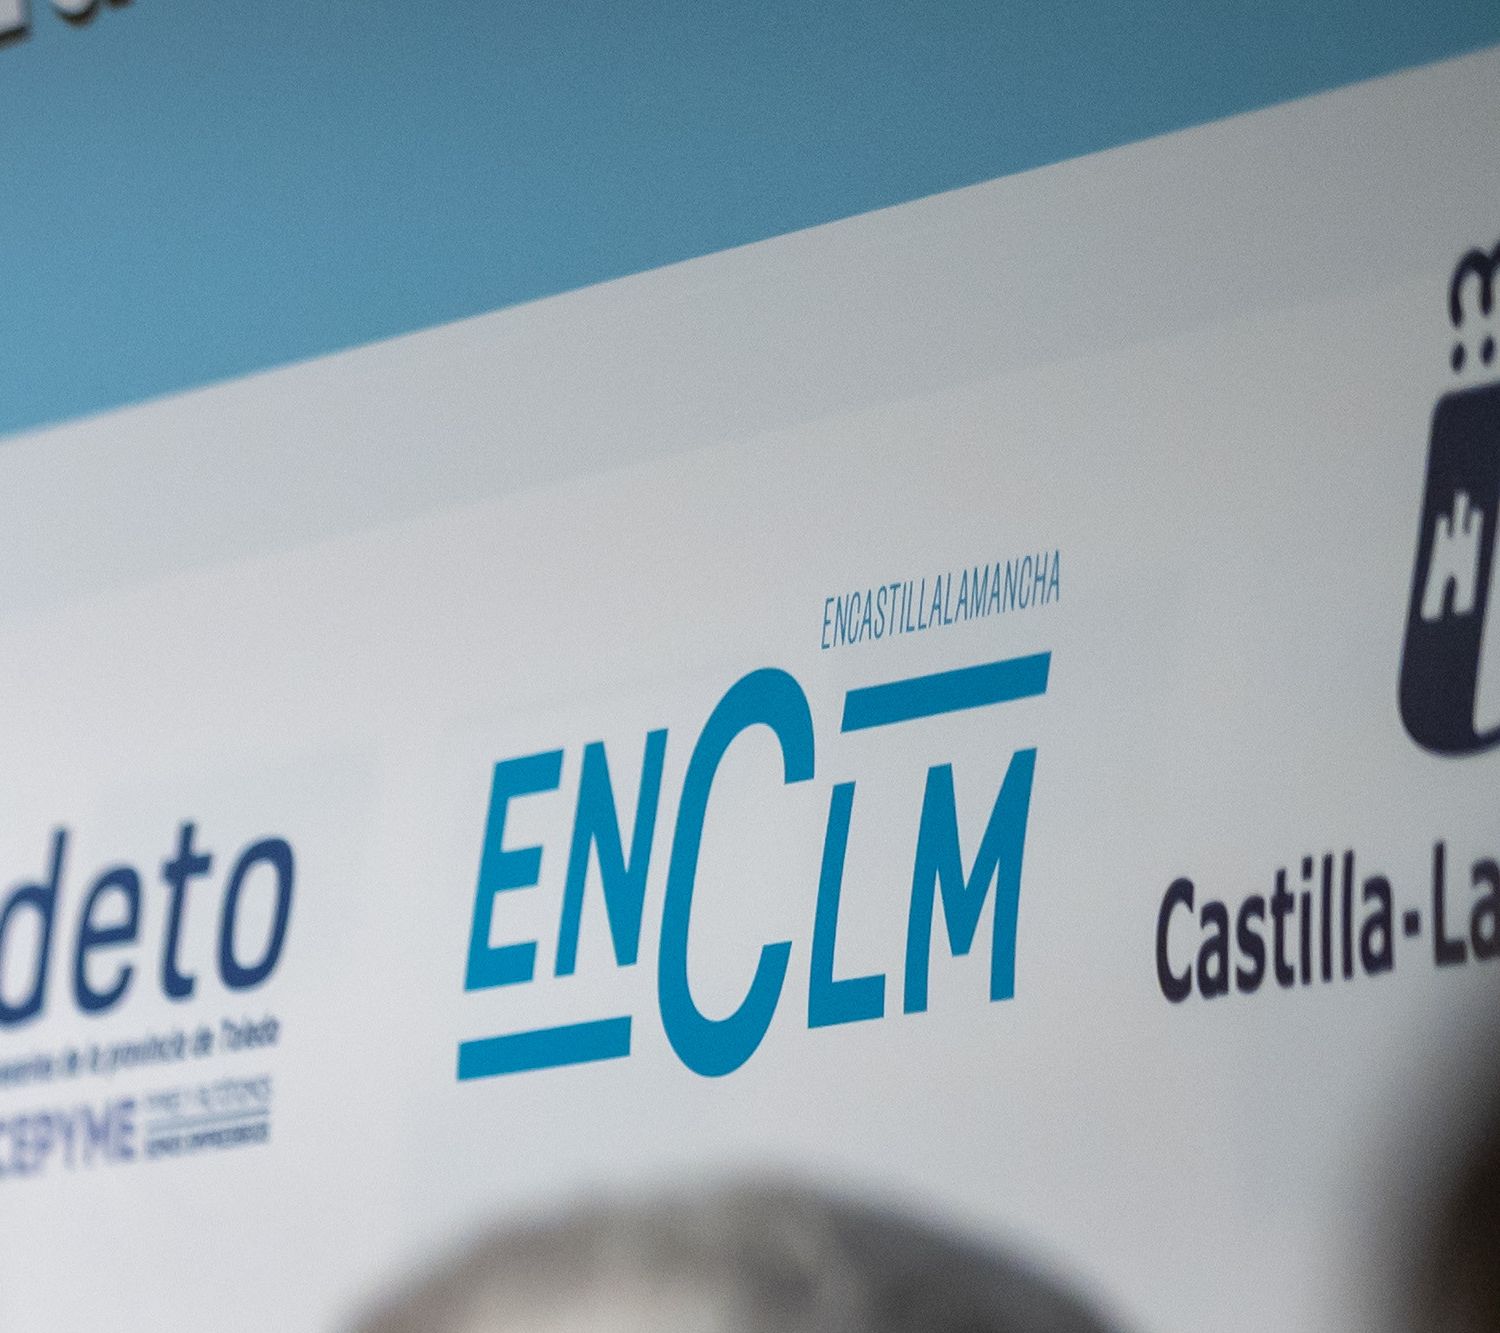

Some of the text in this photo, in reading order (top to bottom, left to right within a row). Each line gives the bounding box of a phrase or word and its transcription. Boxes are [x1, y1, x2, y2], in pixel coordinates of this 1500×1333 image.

[821, 550, 1060, 650] ENCASTILLALAMANCHA
[463, 667, 1037, 1077] ENCLM
[1155, 839, 1500, 1004] Castilla-La
